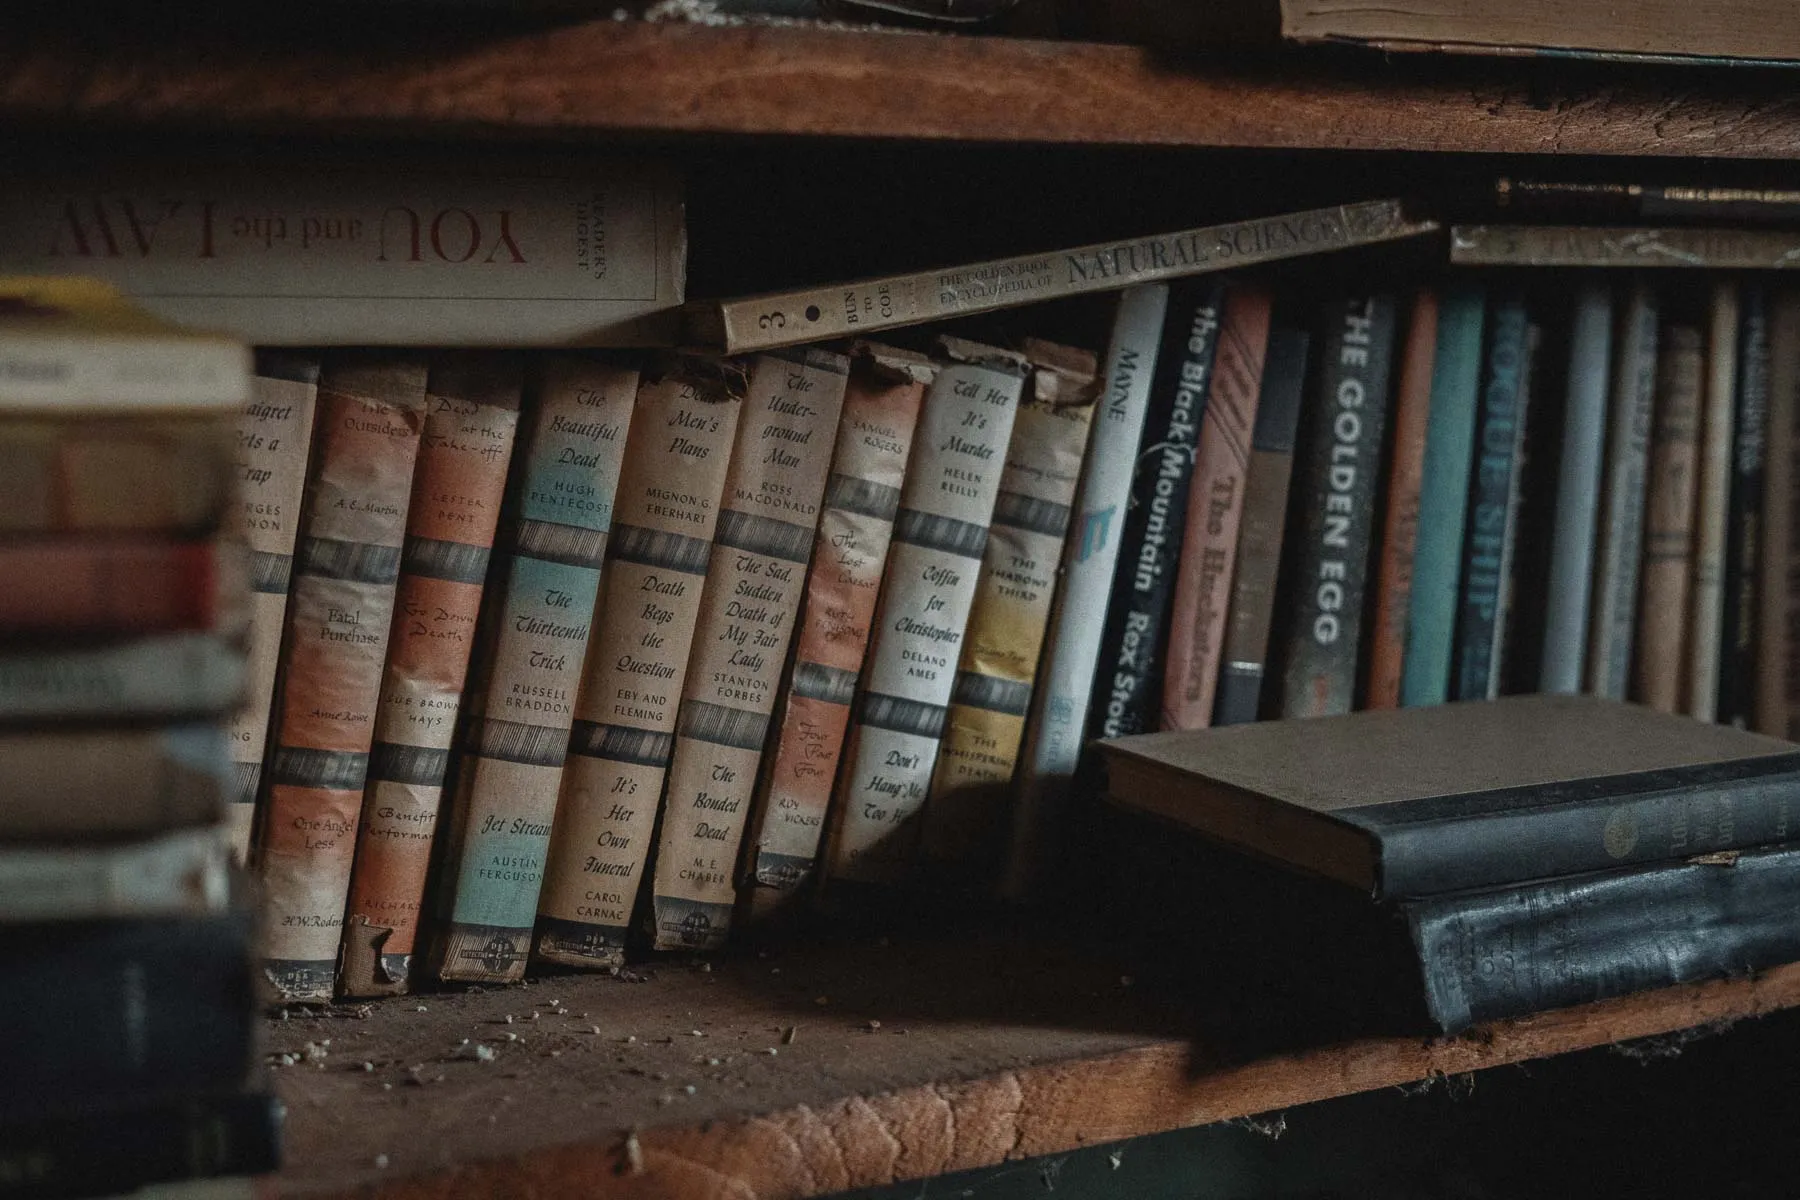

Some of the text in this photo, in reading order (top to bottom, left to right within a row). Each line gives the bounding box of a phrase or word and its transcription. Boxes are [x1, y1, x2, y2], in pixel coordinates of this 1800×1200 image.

[232, 215, 287, 248] the
[302, 215, 362, 241] and
[375, 204, 528, 264] YOU
[1067, 216, 1339, 283] NATURAL SCIENCE
[962, 267, 1014, 285] GOLDEN
[1017, 260, 1051, 276] BOOK
[847, 291, 858, 324] BUN
[864, 296, 873, 311] TO
[881, 285, 892, 318] COE
[759, 311, 786, 330] 3
[787, 373, 814, 392] The
[1107, 347, 1140, 423] MAYNE
[576, 389, 605, 407] The
[954, 380, 1009, 407] Tell Her
[245, 402, 292, 422] aigret
[767, 396, 818, 417] Under-
[345, 418, 410, 437] Outsiders
[550, 415, 619, 442] Beautiful
[669, 409, 719, 434] Men's
[852, 421, 897, 438] SAMUEL
[961, 411, 988, 430] It's
[461, 424, 504, 440] at the
[763, 424, 812, 445] ground
[268, 438, 280, 450] a
[669, 437, 710, 459] Plans
[863, 436, 904, 454] ROGERS
[941, 435, 993, 461] Murder
[558, 447, 600, 469] Dead
[763, 448, 801, 468] Man
[1322, 379, 1365, 548] GOLDEN
[944, 467, 982, 484] HELEN
[555, 481, 595, 497] HUGH
[761, 482, 792, 495] ROSS
[940, 482, 979, 498] REILLY
[531, 491, 610, 514] PENTECOST
[646, 487, 712, 511] MIGNON G.
[736, 489, 815, 515] MACDONALD
[1207, 476, 1236, 536] The
[360, 503, 399, 516] Martin
[646, 504, 706, 525] EBERHART
[1103, 303, 1218, 738] the Black Mountain Rex Stou
[831, 531, 858, 550] The
[736, 555, 792, 583] The Sad,
[838, 552, 866, 568] Lost
[1011, 555, 1036, 570] THE
[641, 575, 685, 597] Death
[922, 565, 961, 587] Coffin
[545, 588, 573, 608] The
[735, 580, 783, 603] Sudden
[997, 584, 1037, 602] THIRD
[403, 602, 474, 623] Go Down
[924, 594, 945, 613] for
[1313, 560, 1347, 645] EGG
[327, 608, 362, 626] Fatal
[641, 603, 674, 625] Begs
[726, 601, 784, 628] Death of
[320, 628, 380, 646] Purchase
[410, 622, 463, 642] Death
[515, 614, 587, 642] Thirteenth
[719, 624, 779, 648] My Fair
[895, 617, 960, 644] Christopher
[641, 632, 664, 649] the
[530, 650, 566, 672] Trick
[616, 655, 675, 680] Question
[728, 650, 765, 672] Lady
[902, 650, 947, 667] DELANO
[714, 673, 769, 690] STANTON
[907, 667, 936, 681] AMES
[513, 683, 567, 700] RUSSELL
[617, 689, 667, 706] EBY AND
[718, 688, 761, 703] FORBES
[420, 699, 461, 712] BROWN
[506, 697, 570, 714] BRADDON
[614, 705, 664, 722] FLEMING
[310, 709, 369, 723] Anne Rowe
[409, 714, 442, 728] HAYS
[972, 735, 998, 749] THE
[884, 750, 920, 770] Don't
[712, 765, 736, 783] The
[611, 776, 638, 795] It's
[864, 775, 903, 797] Hang
[604, 804, 634, 822] Her
[693, 792, 741, 814] Bonded
[779, 799, 800, 810] ROY
[864, 803, 885, 821] Too
[378, 806, 435, 824] Benefit
[481, 814, 507, 835] Jet
[784, 813, 822, 827] VICKERS
[293, 816, 355, 837] One Angel
[369, 826, 433, 842] erforma
[694, 822, 730, 842] Dead
[305, 838, 336, 850] Less
[598, 830, 630, 850] Own
[492, 856, 538, 869] AUSTIN
[584, 856, 635, 878] Funeral
[679, 870, 726, 886] CHABER
[585, 891, 622, 905] CAROL
[577, 906, 624, 921] CARNAC
